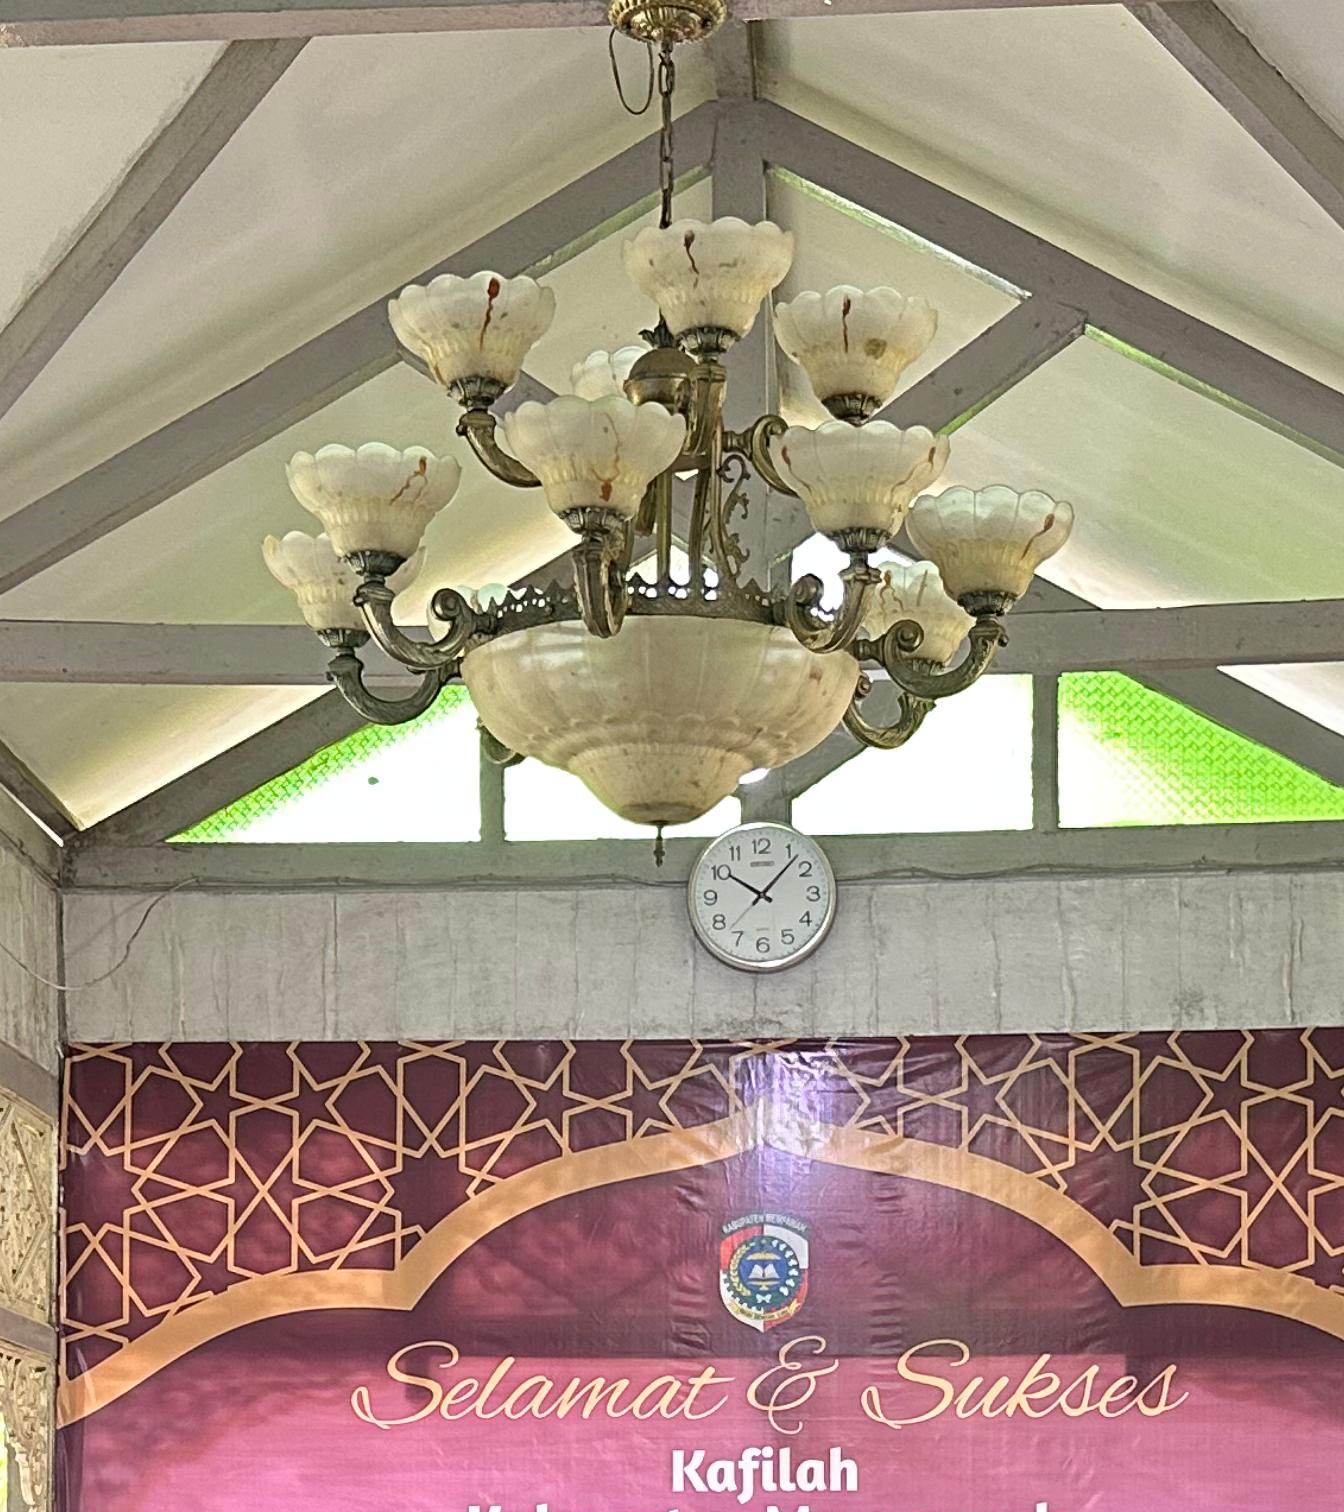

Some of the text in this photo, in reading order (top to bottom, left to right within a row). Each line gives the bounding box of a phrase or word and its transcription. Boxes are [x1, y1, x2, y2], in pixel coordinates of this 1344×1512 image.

[729, 845, 741, 862] 11
[752, 838, 771, 855] 12
[711, 864, 732, 881] 10
[799, 861, 813, 878] 2
[703, 889, 718, 906] 9
[806, 886, 821, 902] 3
[712, 914, 726, 931] 8
[799, 910, 813, 927] 4
[731, 931, 744, 948] 7
[756, 937, 770, 953] 6
[781, 929, 795, 945] 5
[350, 1335, 1190, 1435] Selamat & Sukses
[671, 1448, 858, 1504] Kafilah
